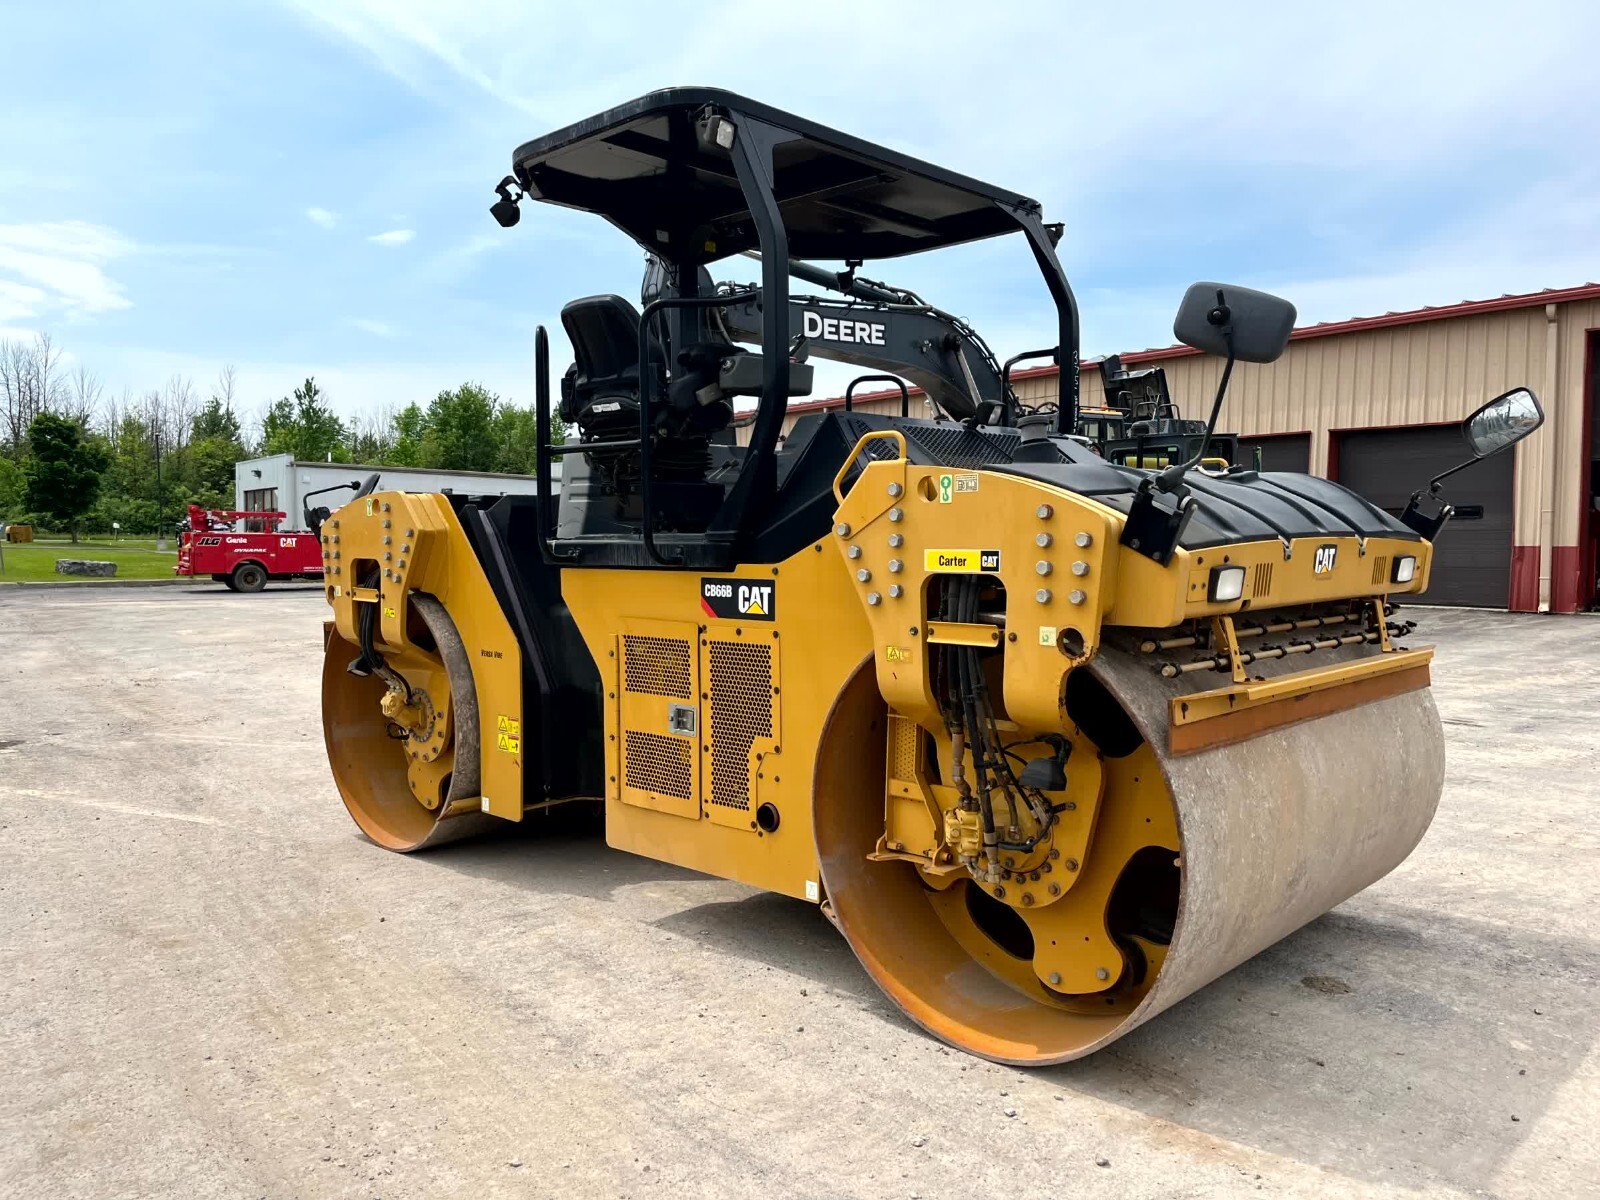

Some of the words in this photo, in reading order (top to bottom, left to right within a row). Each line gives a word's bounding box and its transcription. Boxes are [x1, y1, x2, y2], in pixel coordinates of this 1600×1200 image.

[803, 311, 886, 345] DEERE
[196, 537, 222, 546] JLG
[280, 537, 297, 548] CAT
[938, 555, 967, 567] Carter
[981, 555, 998, 567] CAT
[1314, 548, 1336, 574] CAT
[704, 584, 733, 598] CB66B
[738, 585, 772, 615] CAT
